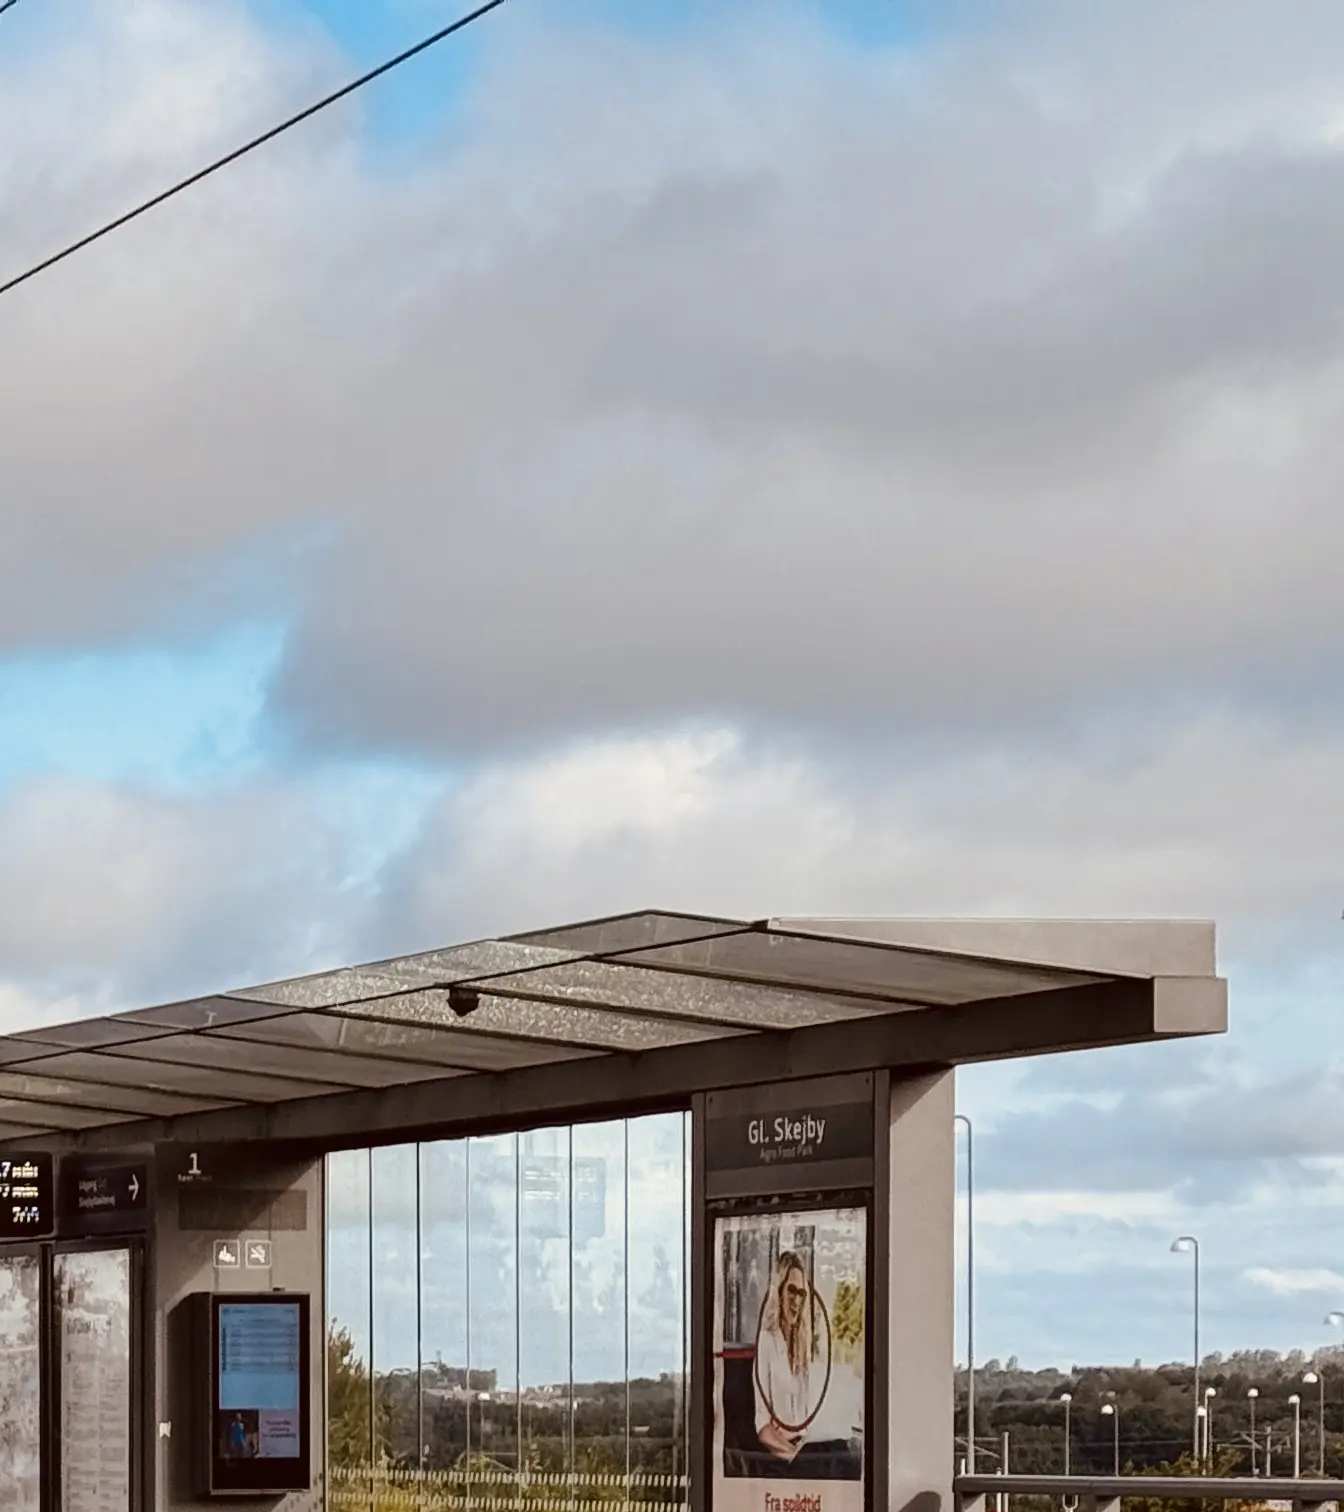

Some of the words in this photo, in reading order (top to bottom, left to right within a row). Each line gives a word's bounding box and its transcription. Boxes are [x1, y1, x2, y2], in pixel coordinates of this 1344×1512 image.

[748, 1119, 769, 1144] Gl.
[774, 1113, 826, 1145] Skejby
[188, 1152, 202, 1175] 1
[764, 1492, 782, 1512] Fra
